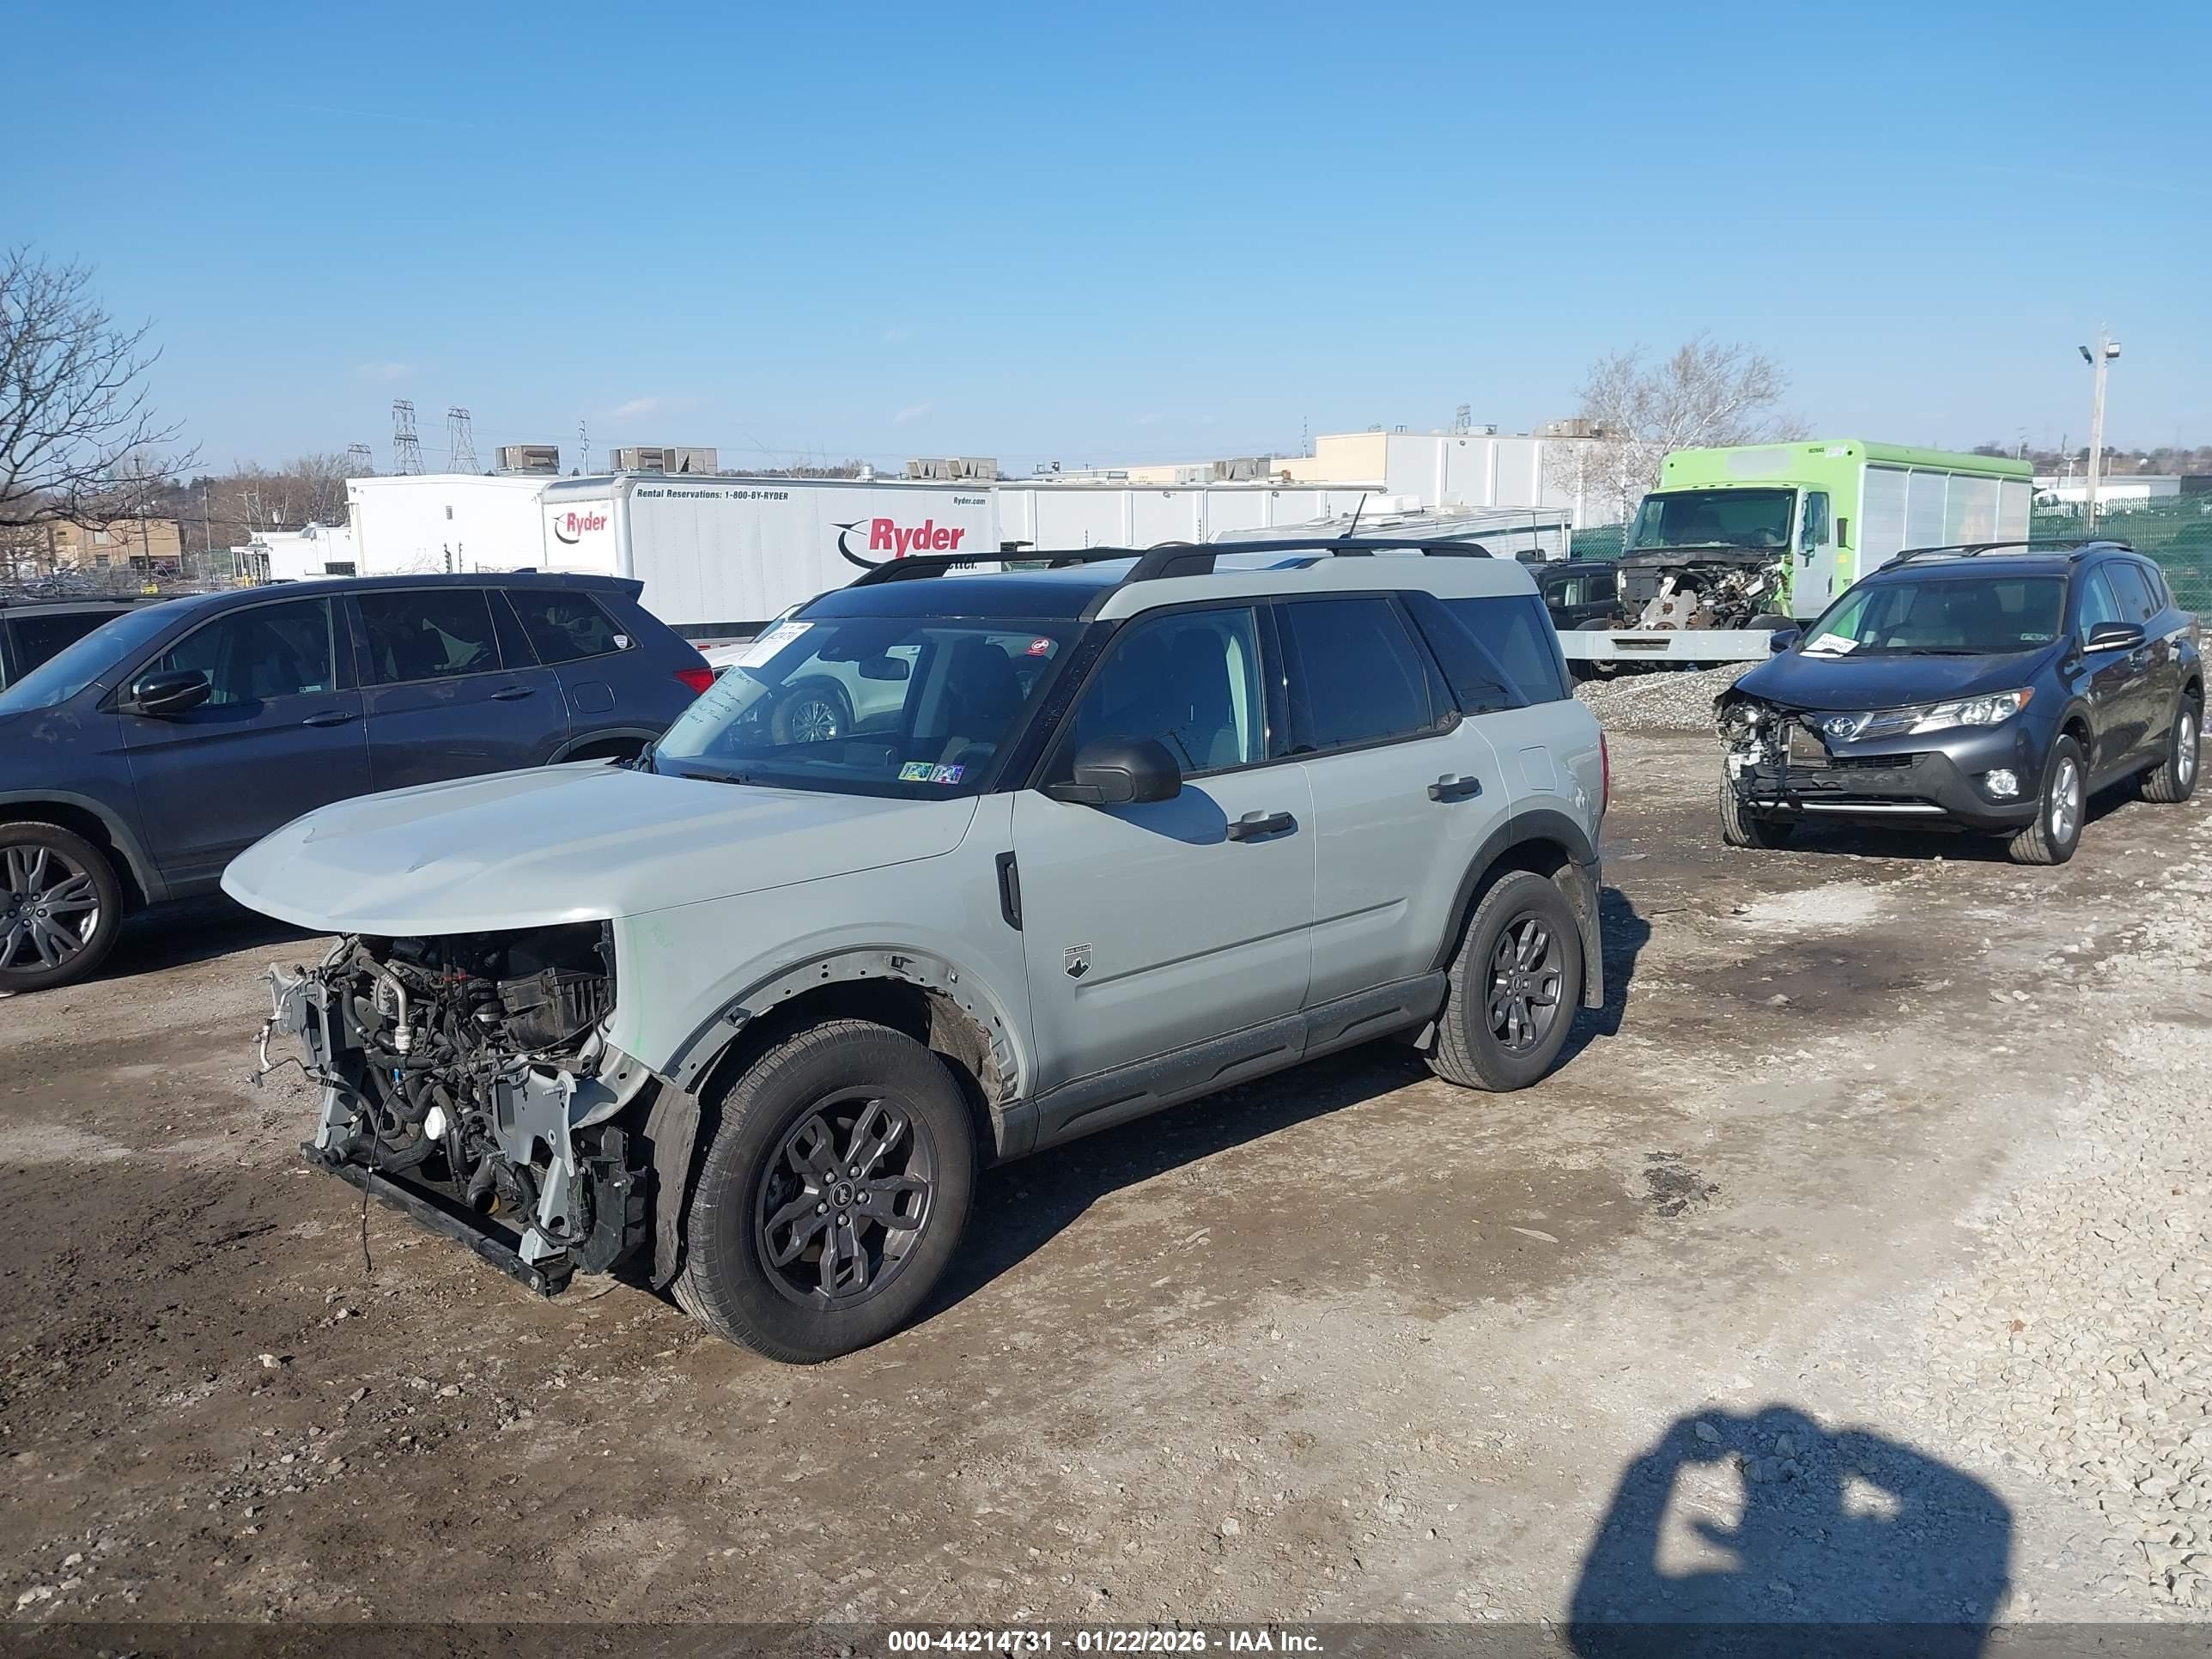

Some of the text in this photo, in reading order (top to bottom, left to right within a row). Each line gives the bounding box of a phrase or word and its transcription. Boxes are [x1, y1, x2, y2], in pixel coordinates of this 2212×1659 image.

[637, 489, 789, 501] Rental Reservations: 1-800-BY-RYDER
[953, 496, 986, 506] Ryder.com
[567, 511, 607, 537] Ryder
[869, 518, 965, 559] Ryder
